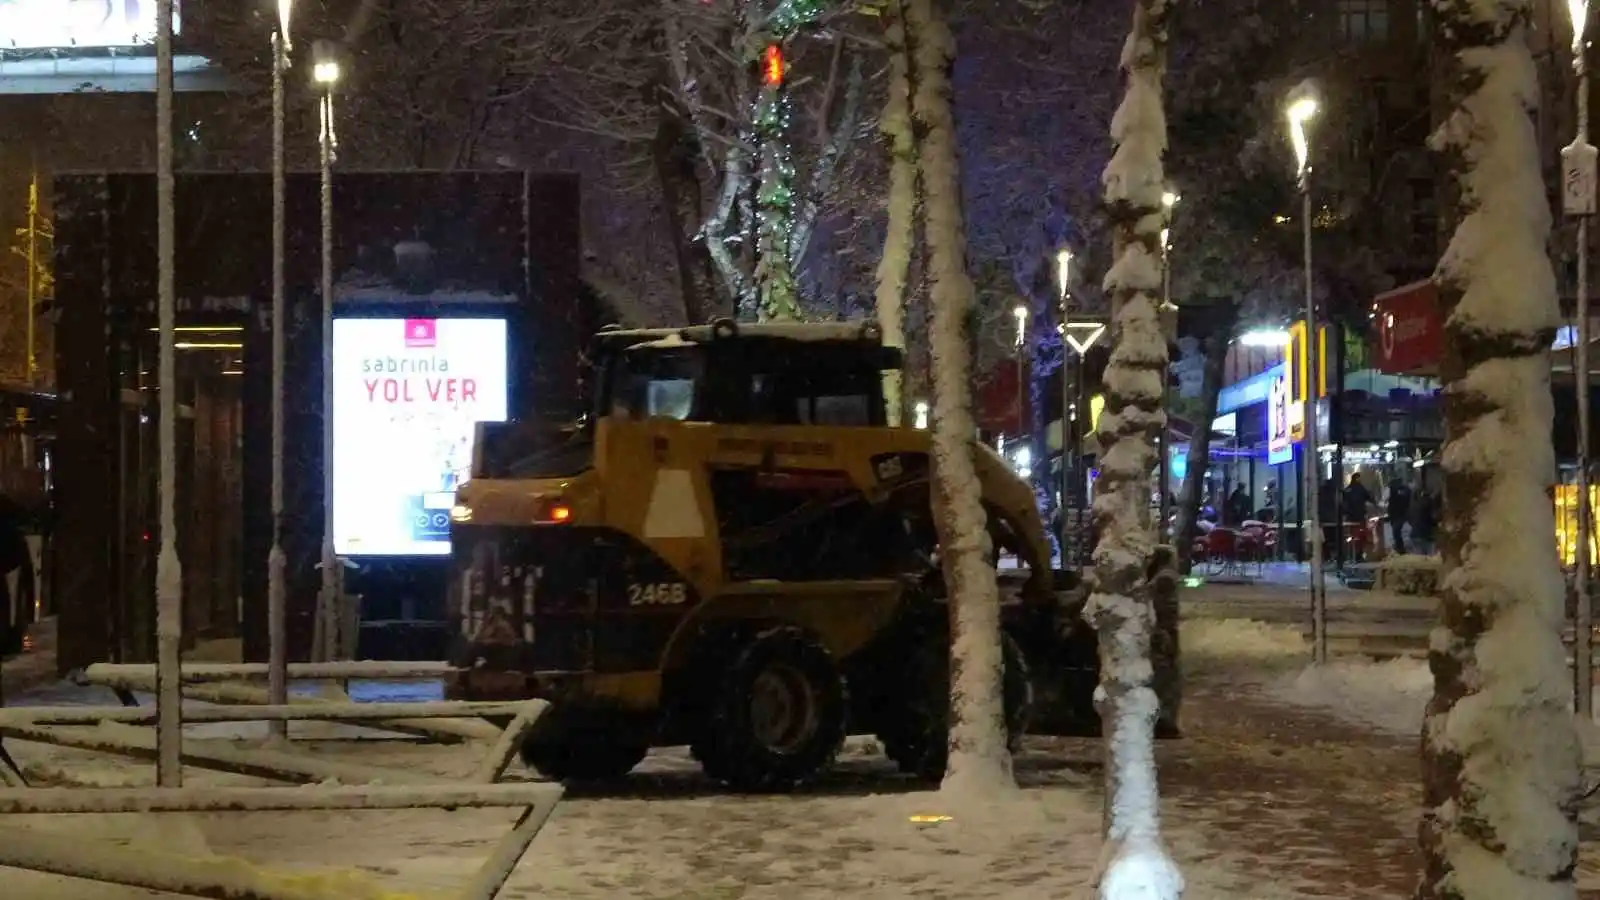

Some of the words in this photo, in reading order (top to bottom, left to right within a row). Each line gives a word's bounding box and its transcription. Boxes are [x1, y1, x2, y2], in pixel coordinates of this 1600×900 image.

[365, 379, 413, 402] YOL
[426, 379, 477, 402] VER
[628, 583, 688, 606] 246B
